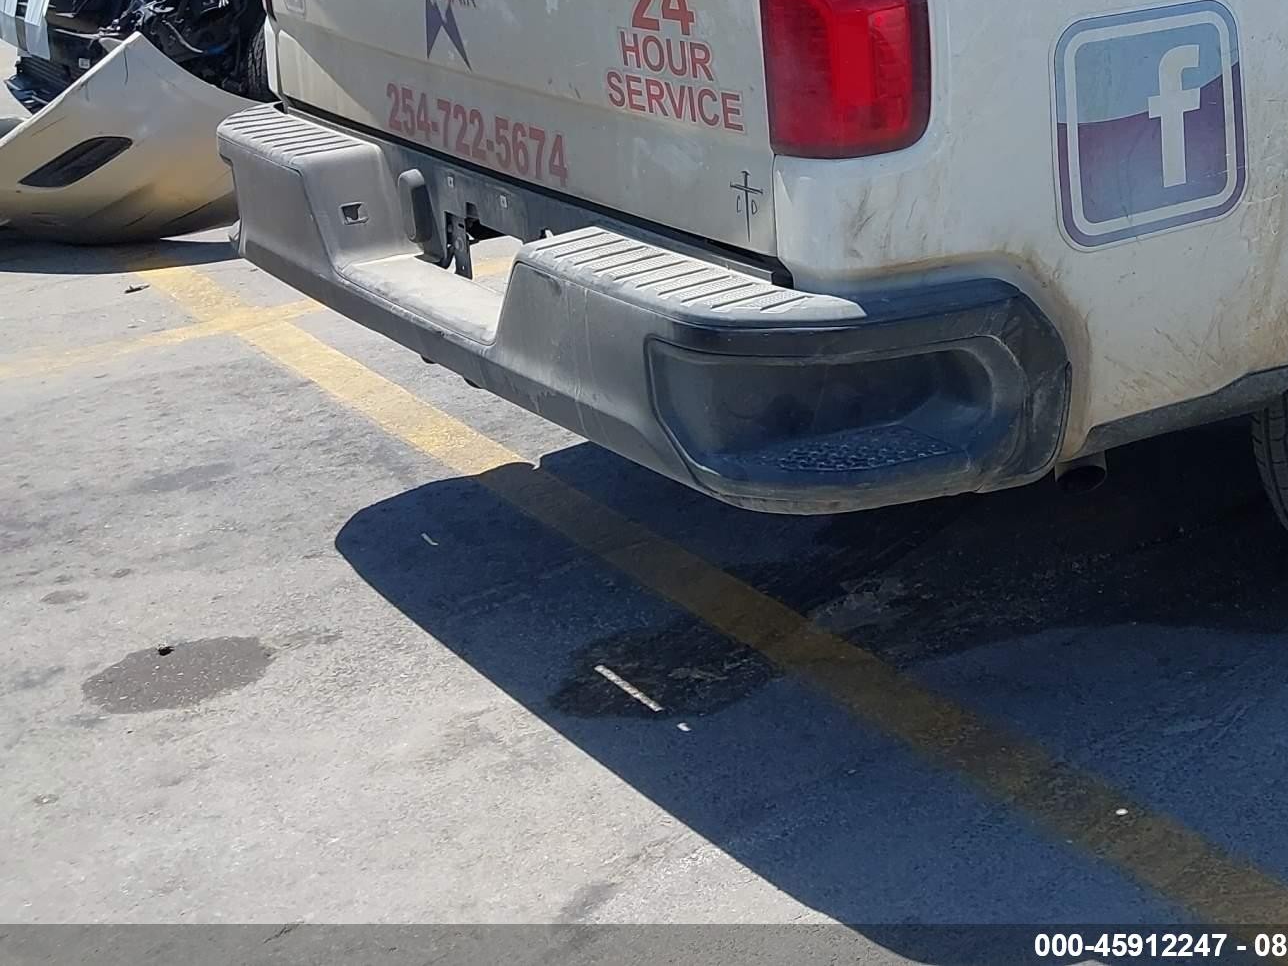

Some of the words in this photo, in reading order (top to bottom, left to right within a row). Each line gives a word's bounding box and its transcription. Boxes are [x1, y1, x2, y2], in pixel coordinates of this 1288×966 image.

[620, 30, 714, 82] HOUR
[606, 71, 744, 132] SERVICE
[385, 82, 569, 188] 254-722-5674
